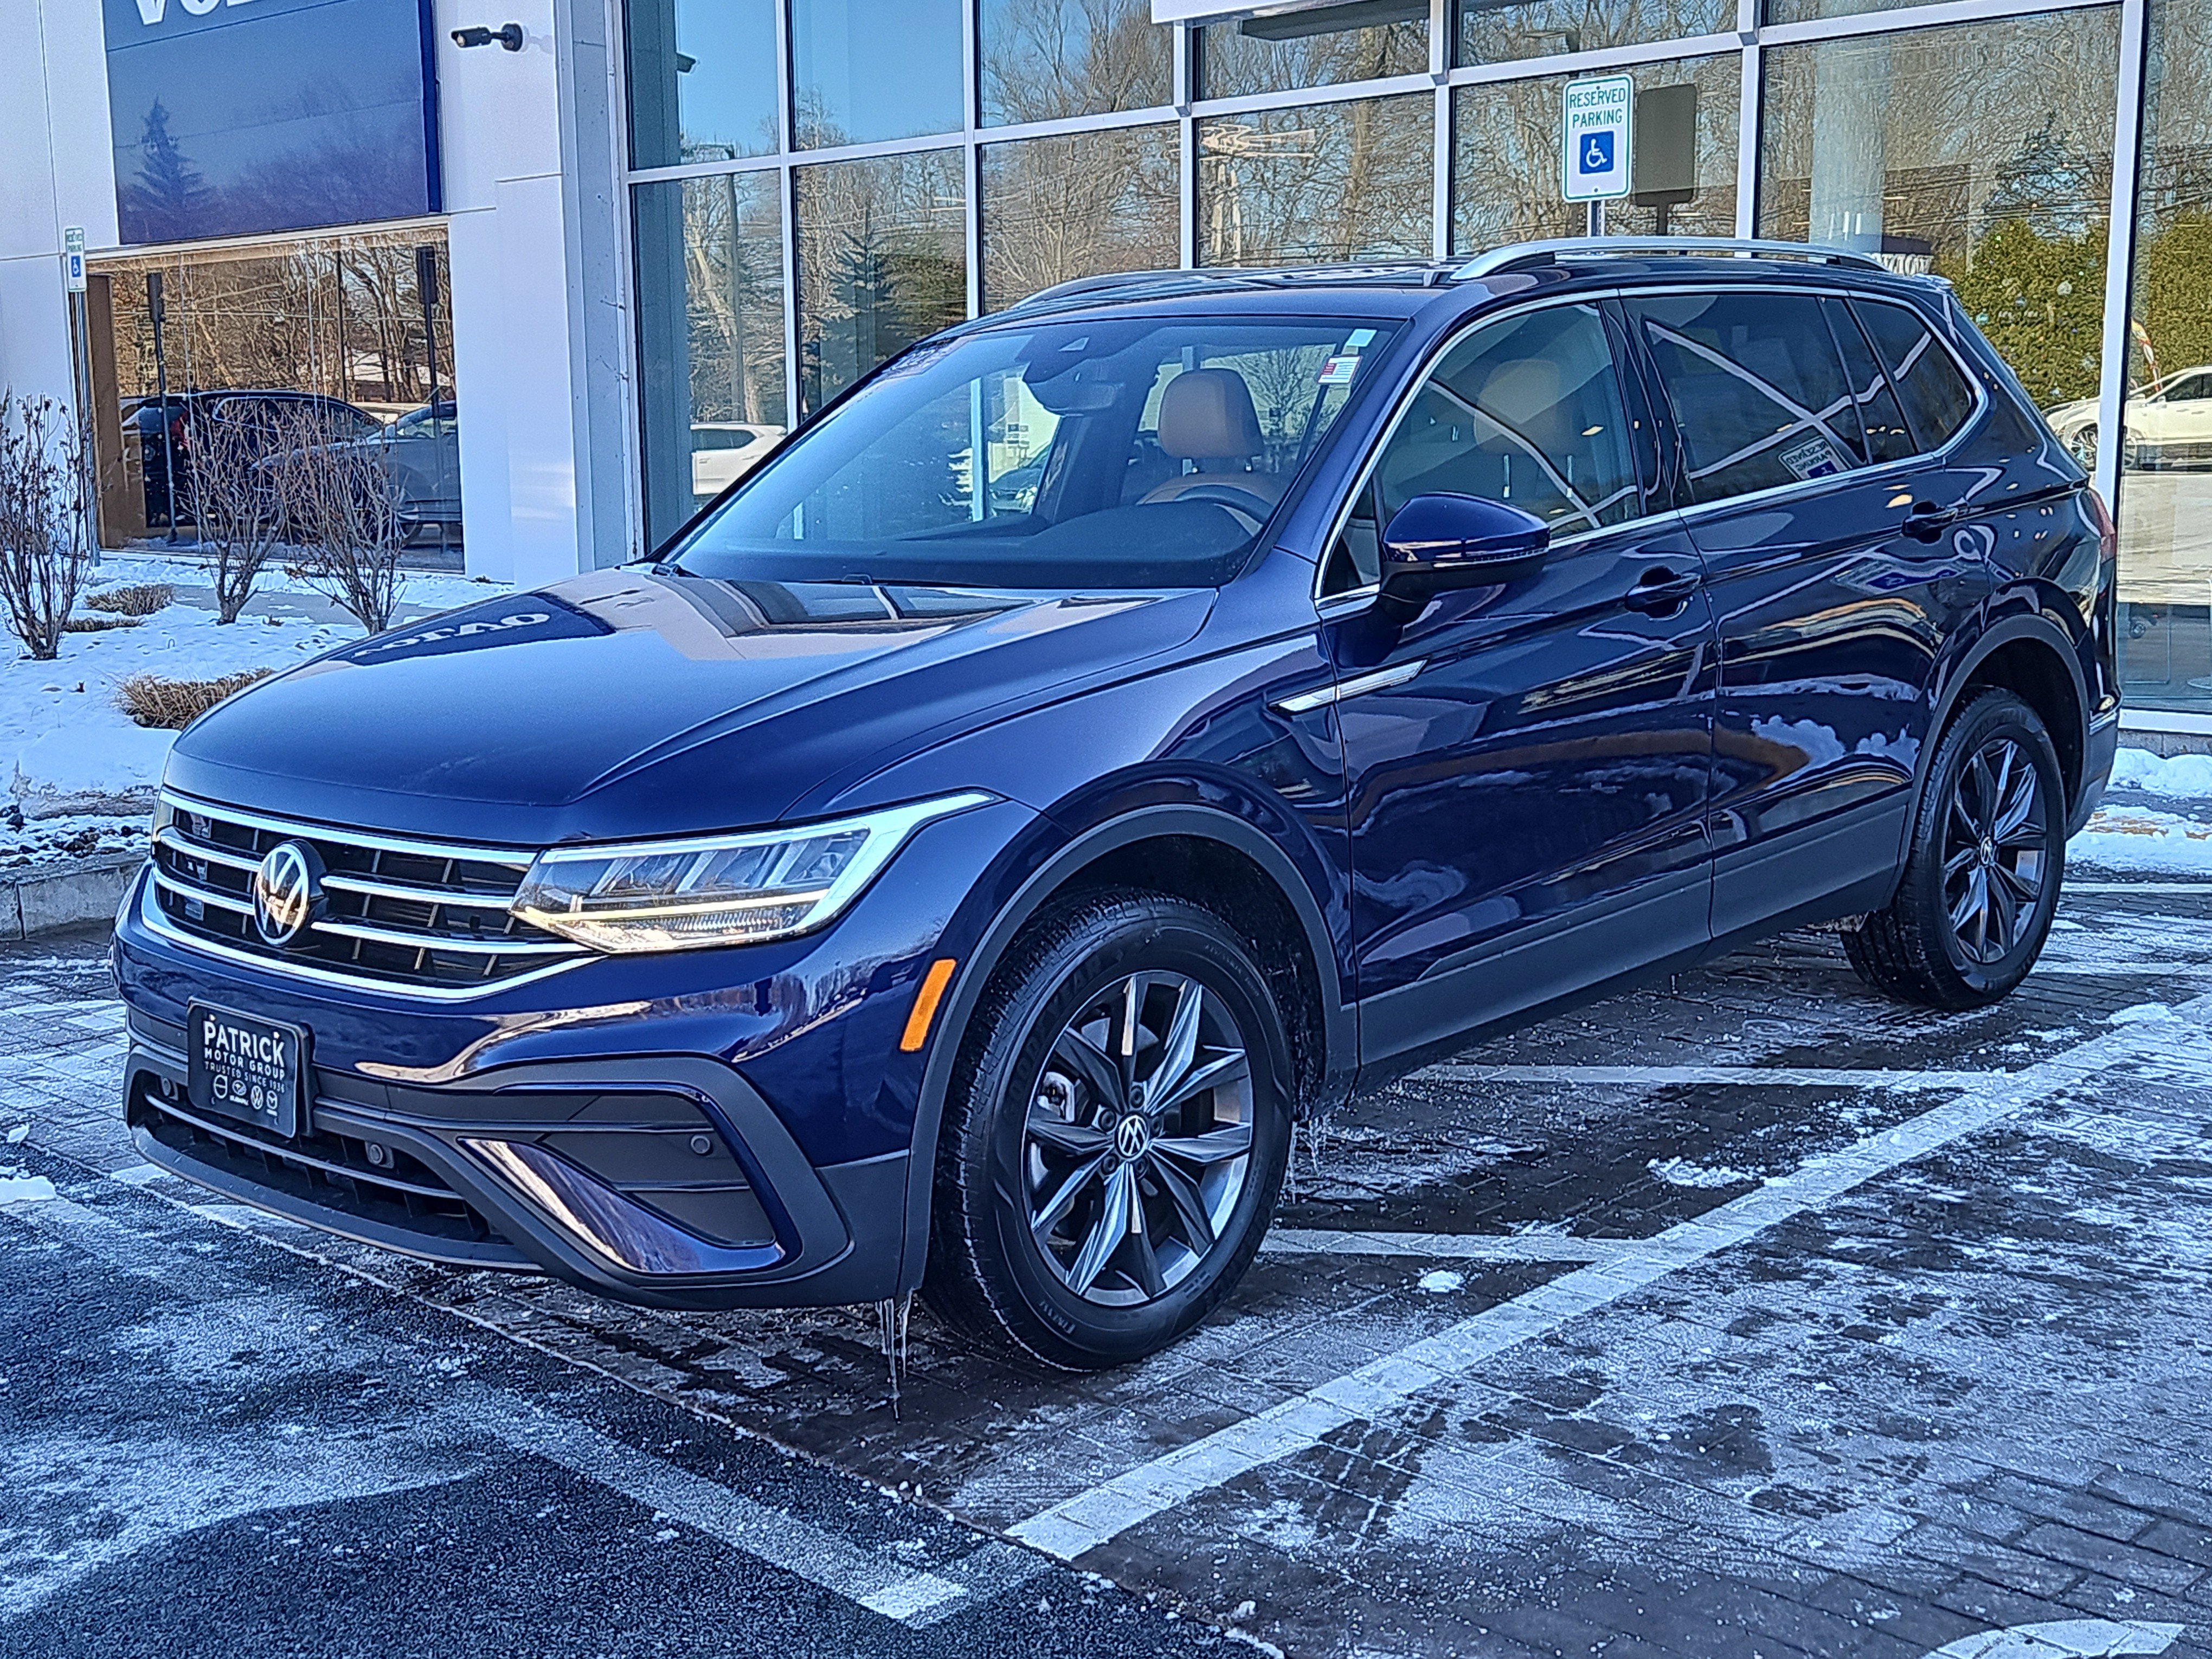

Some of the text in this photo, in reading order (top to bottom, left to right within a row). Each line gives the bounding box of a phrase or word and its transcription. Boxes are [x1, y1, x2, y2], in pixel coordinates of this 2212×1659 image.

[1570, 88, 1626, 108] RESERVED
[1573, 108, 1623, 129] PARKING
[203, 1020, 285, 1068] PATRICK
[204, 1047, 285, 1081] MOTOR GROUP
[204, 1061, 241, 1078] TRUSTED
[244, 1071, 267, 1088] SINCE
